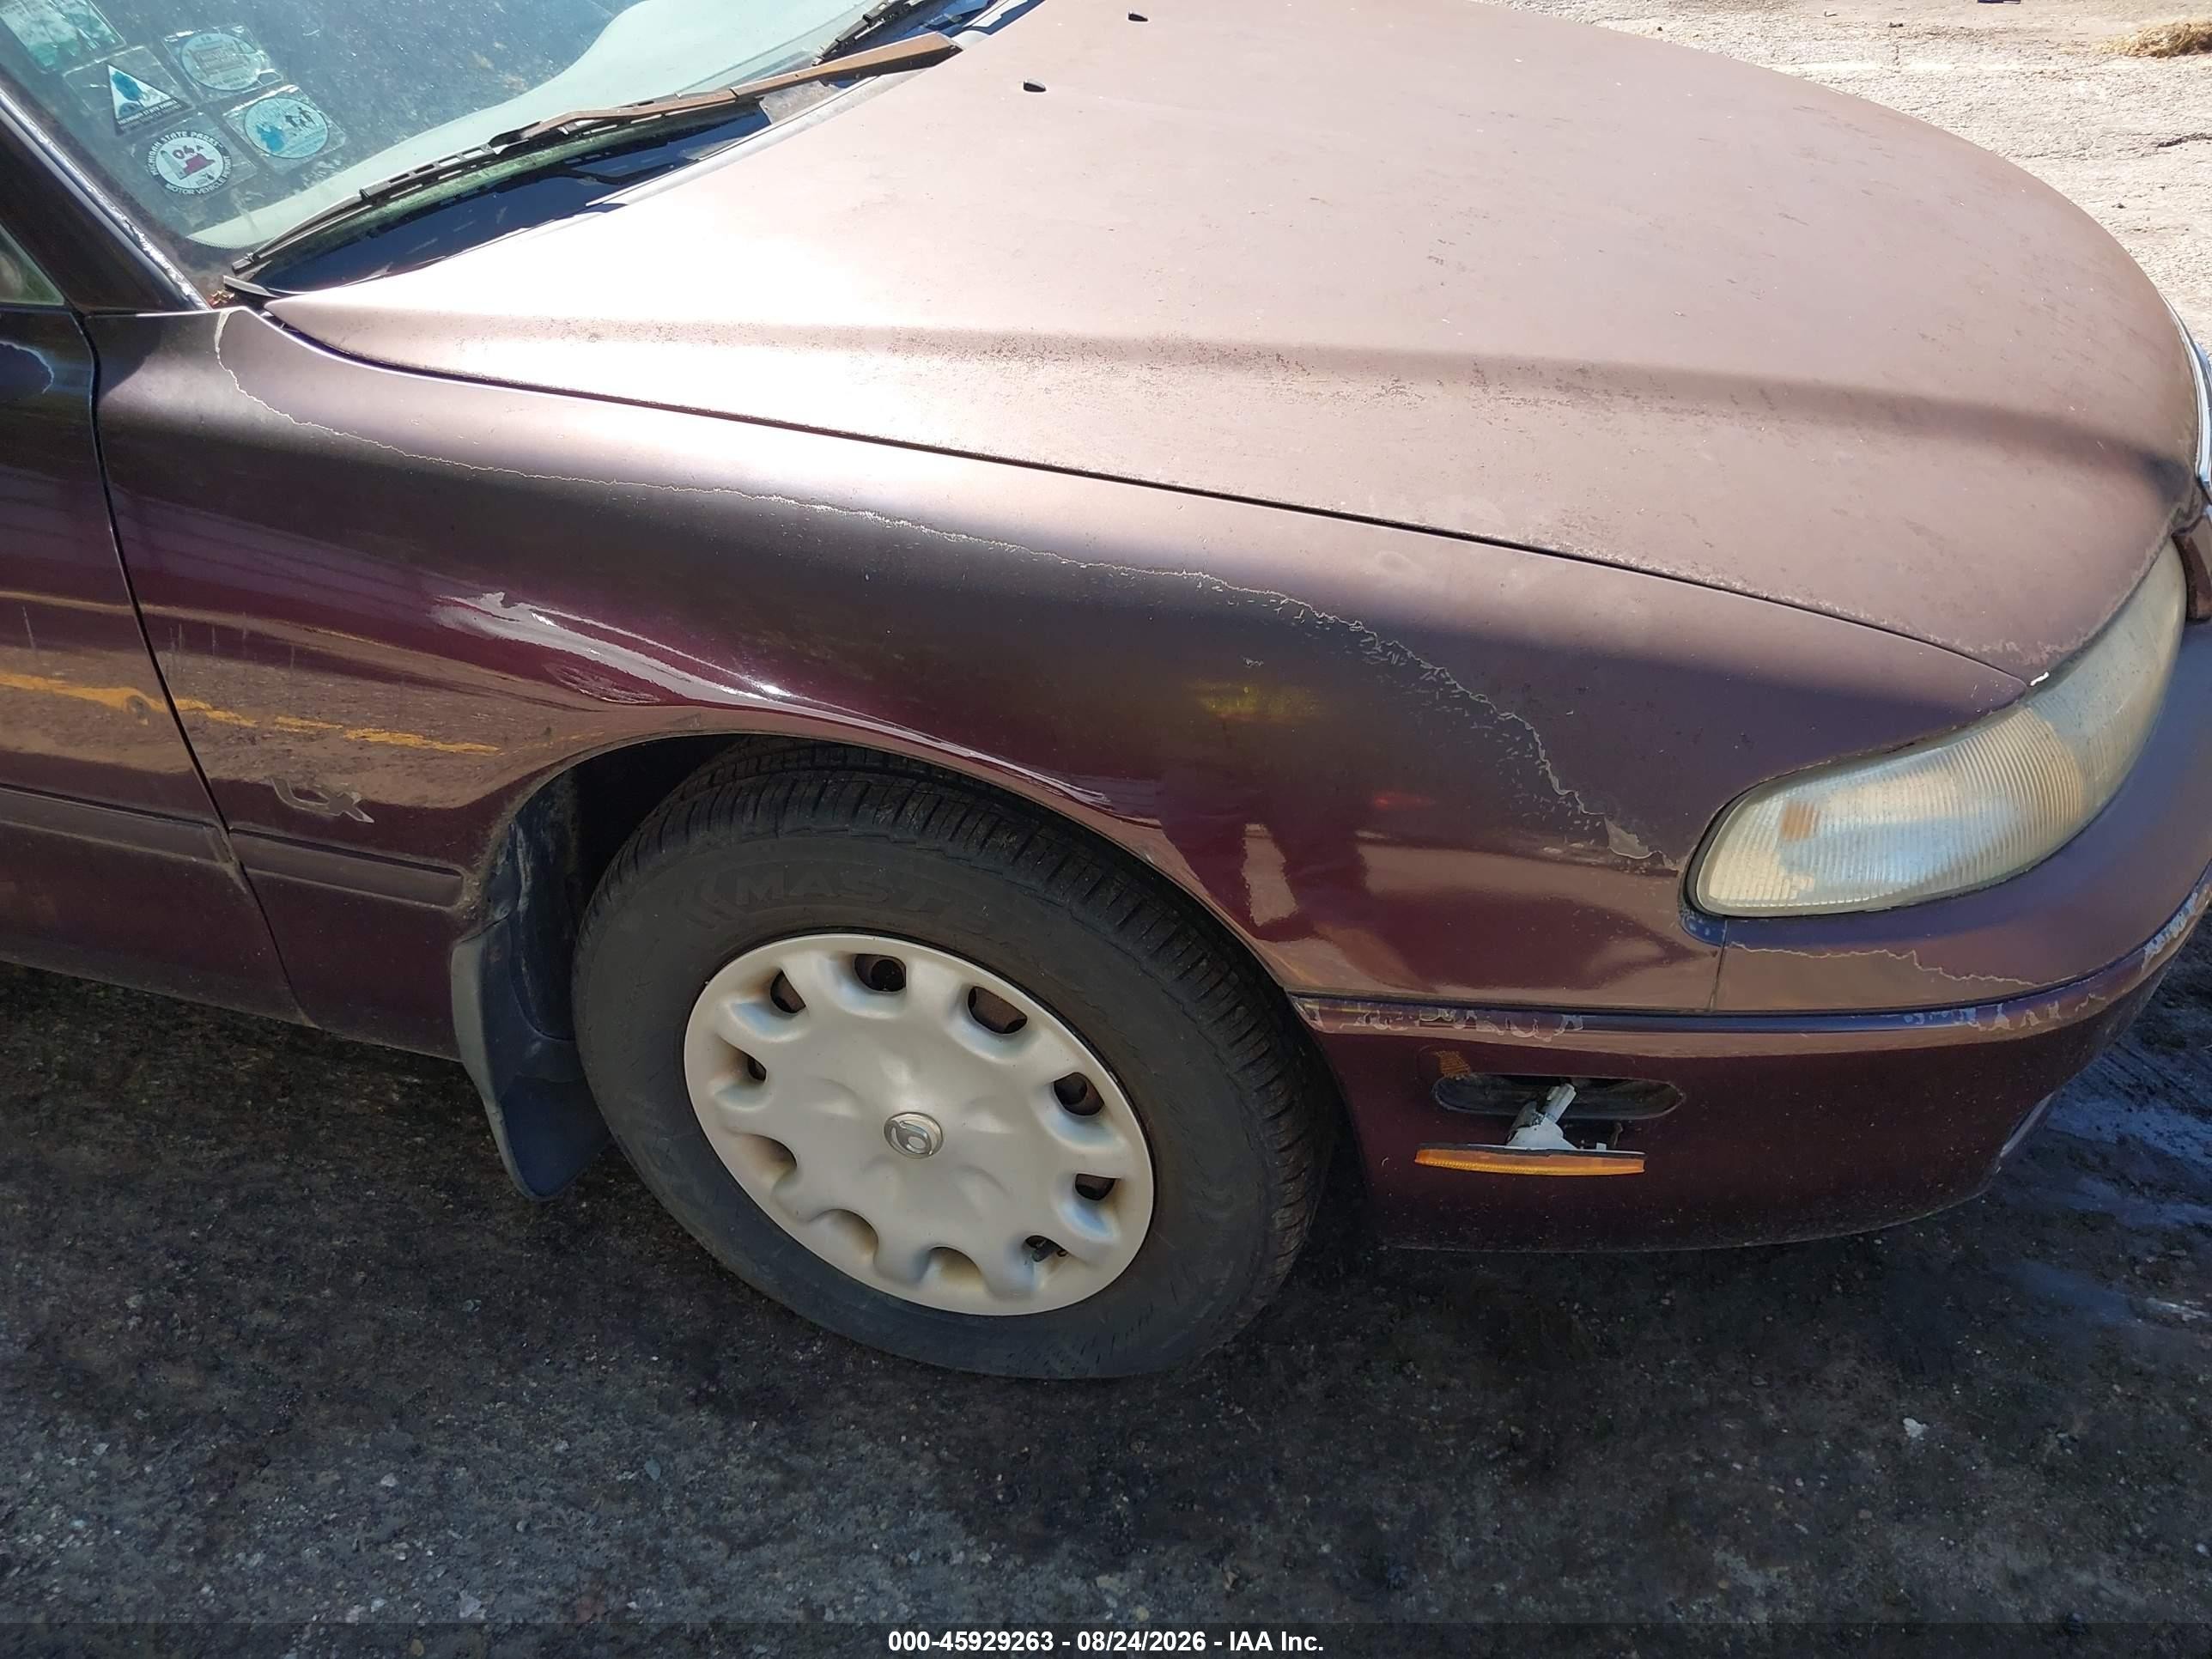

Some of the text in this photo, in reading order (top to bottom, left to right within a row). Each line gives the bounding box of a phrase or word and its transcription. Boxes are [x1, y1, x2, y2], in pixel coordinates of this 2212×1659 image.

[148, 131, 220, 176] MICHIGAN STATE PARKS
[164, 183, 196, 195] MOTOR
[195, 178, 228, 195] VEHICLE
